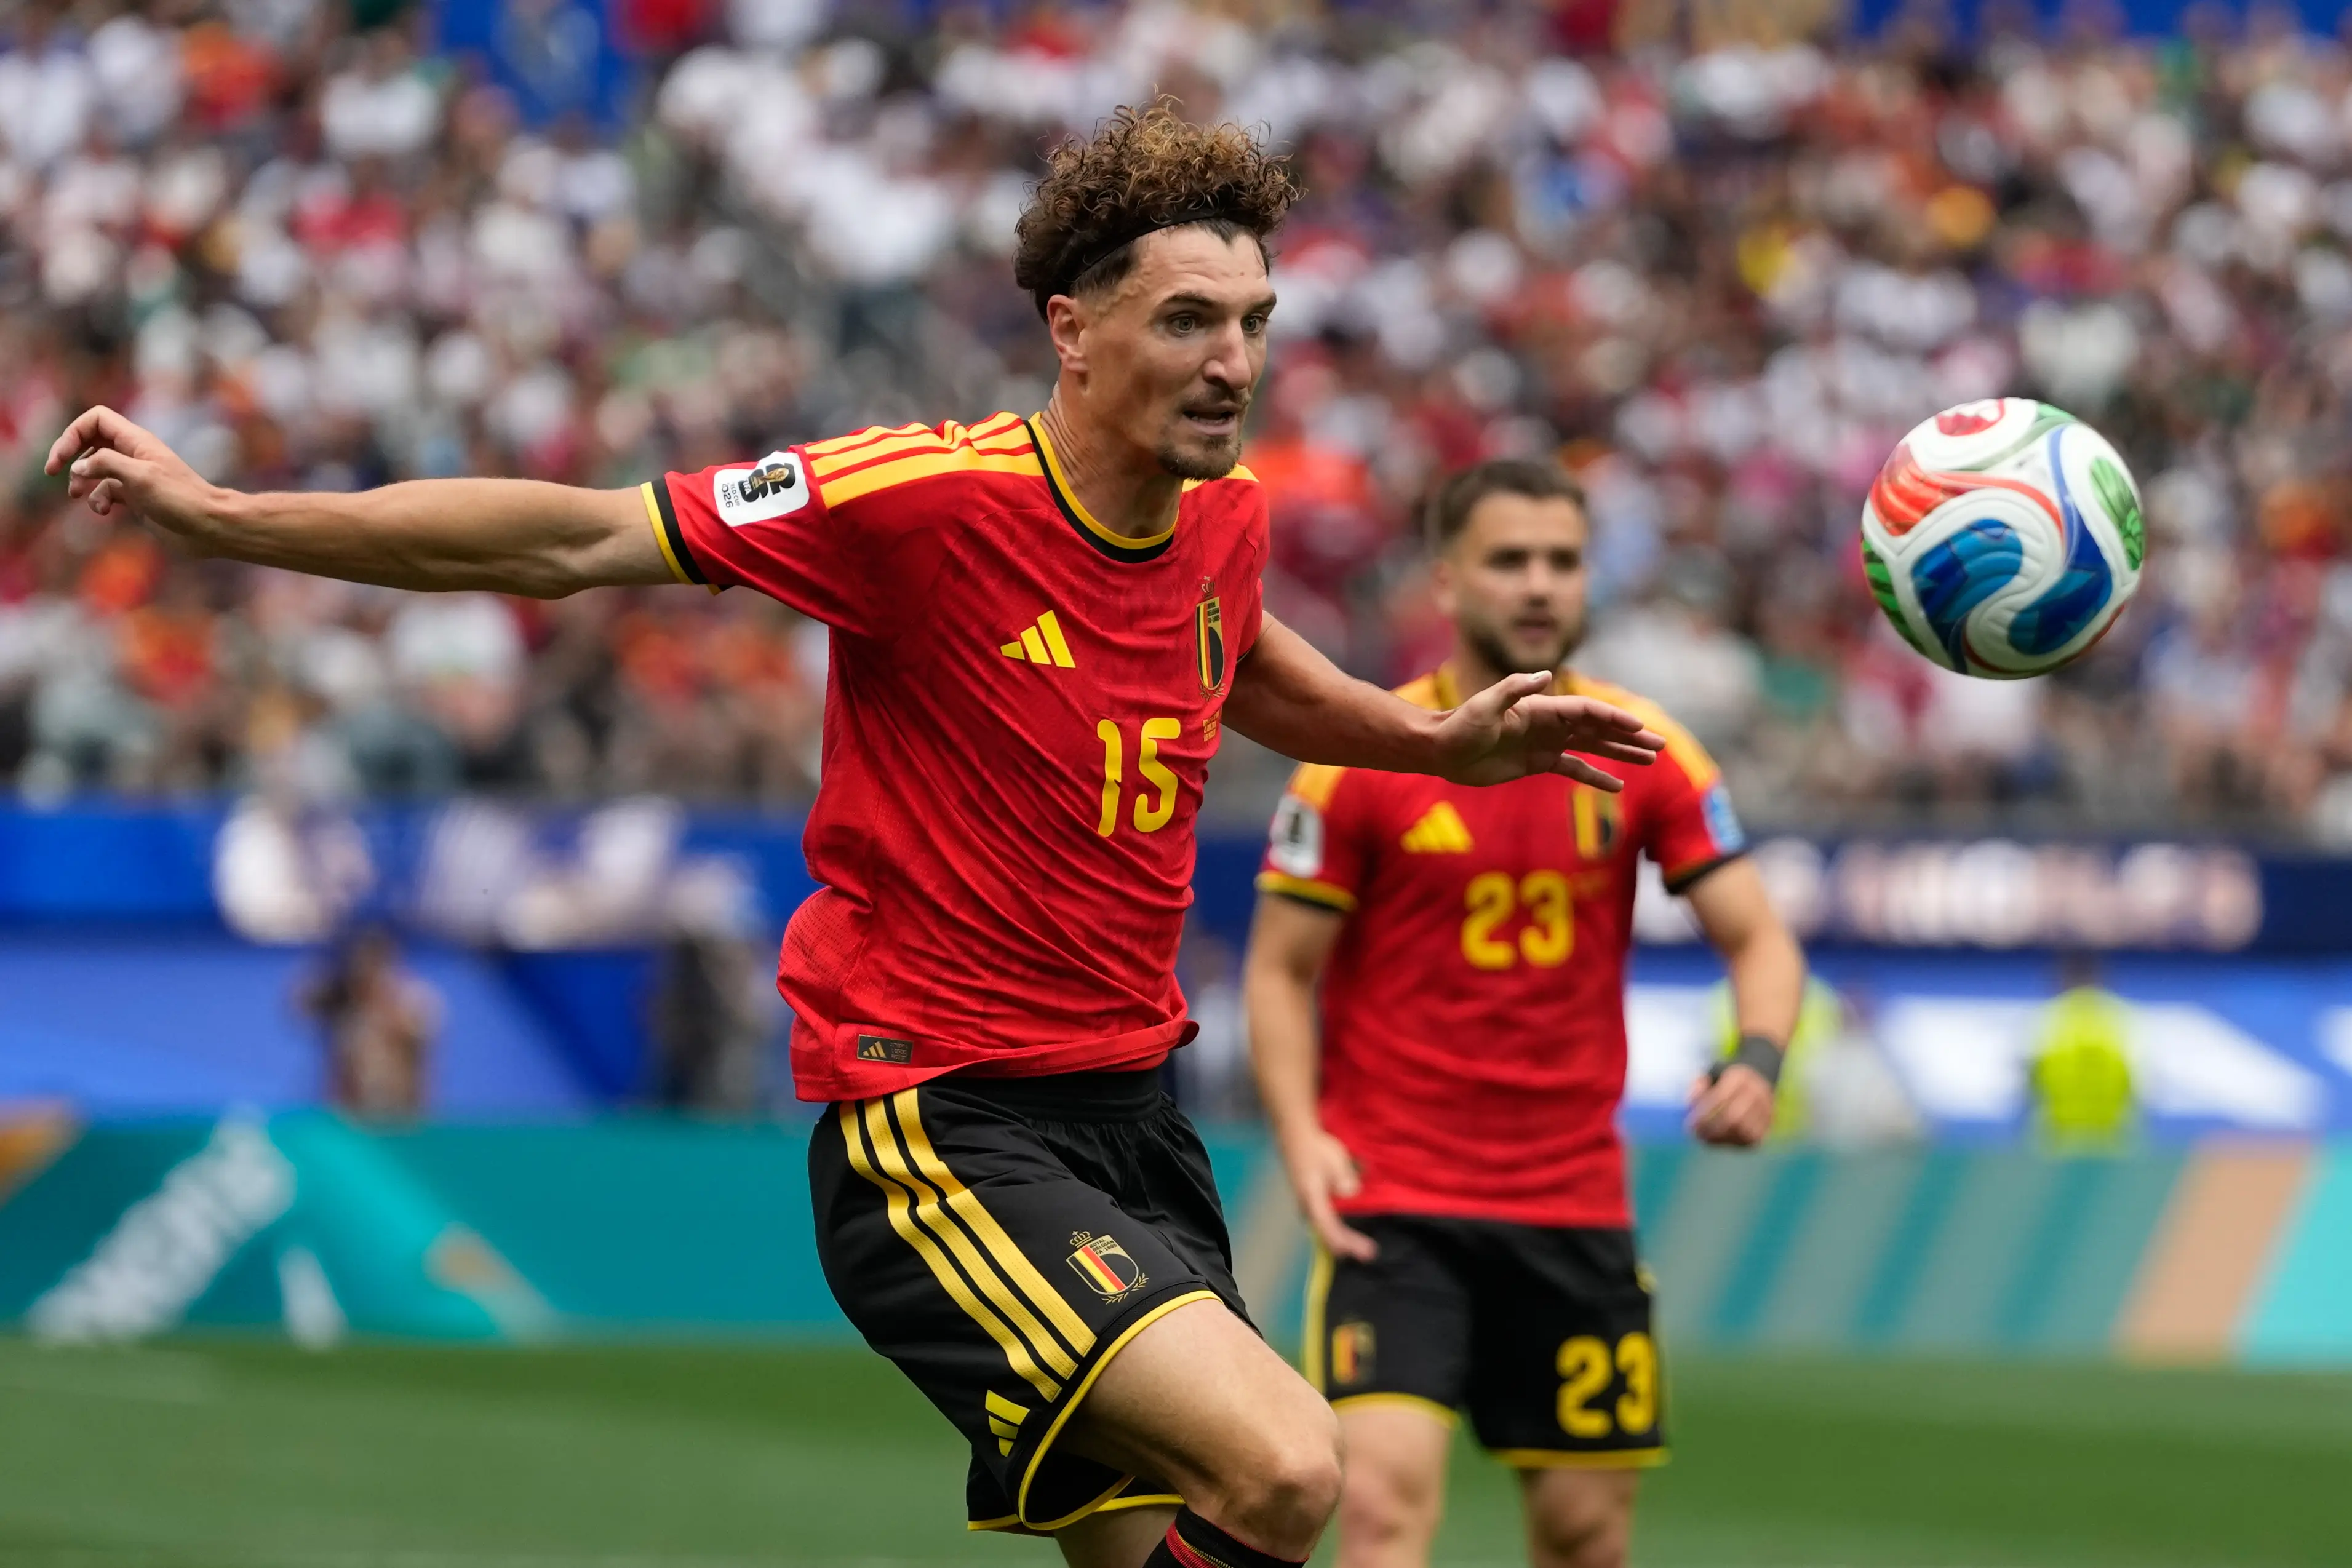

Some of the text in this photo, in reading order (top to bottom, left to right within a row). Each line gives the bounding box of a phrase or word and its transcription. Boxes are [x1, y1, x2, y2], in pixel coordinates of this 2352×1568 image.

[721, 482, 733, 508] 026
[1097, 717, 1181, 837] 15
[1460, 870, 1574, 970] 23
[1089, 1238, 1106, 1248] ROYAL
[1555, 1331, 1659, 1439] 23
